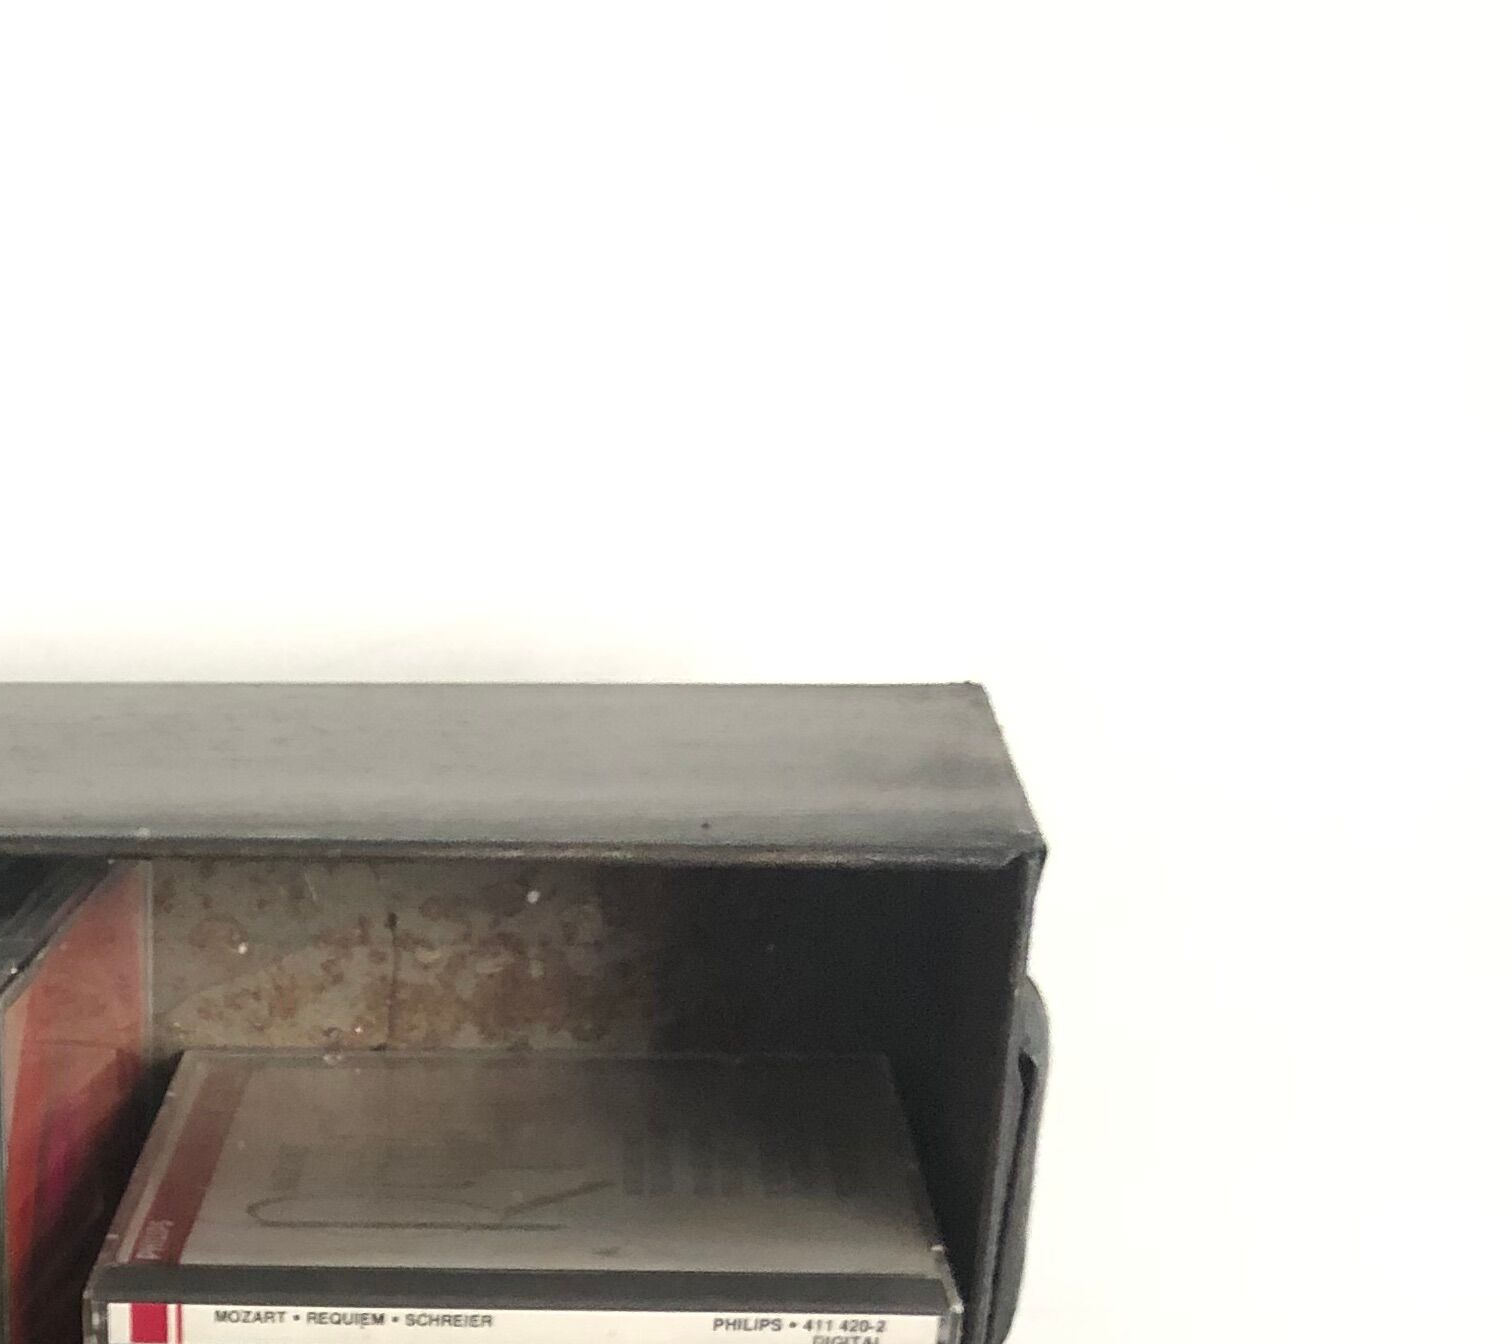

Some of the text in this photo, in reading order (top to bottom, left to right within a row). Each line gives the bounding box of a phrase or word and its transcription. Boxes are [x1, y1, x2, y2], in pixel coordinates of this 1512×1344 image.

[213, 1309, 493, 1329] MOZART REQUIEM SCHREIER
[711, 1317, 887, 1334] PHILIPS 411 420-2
